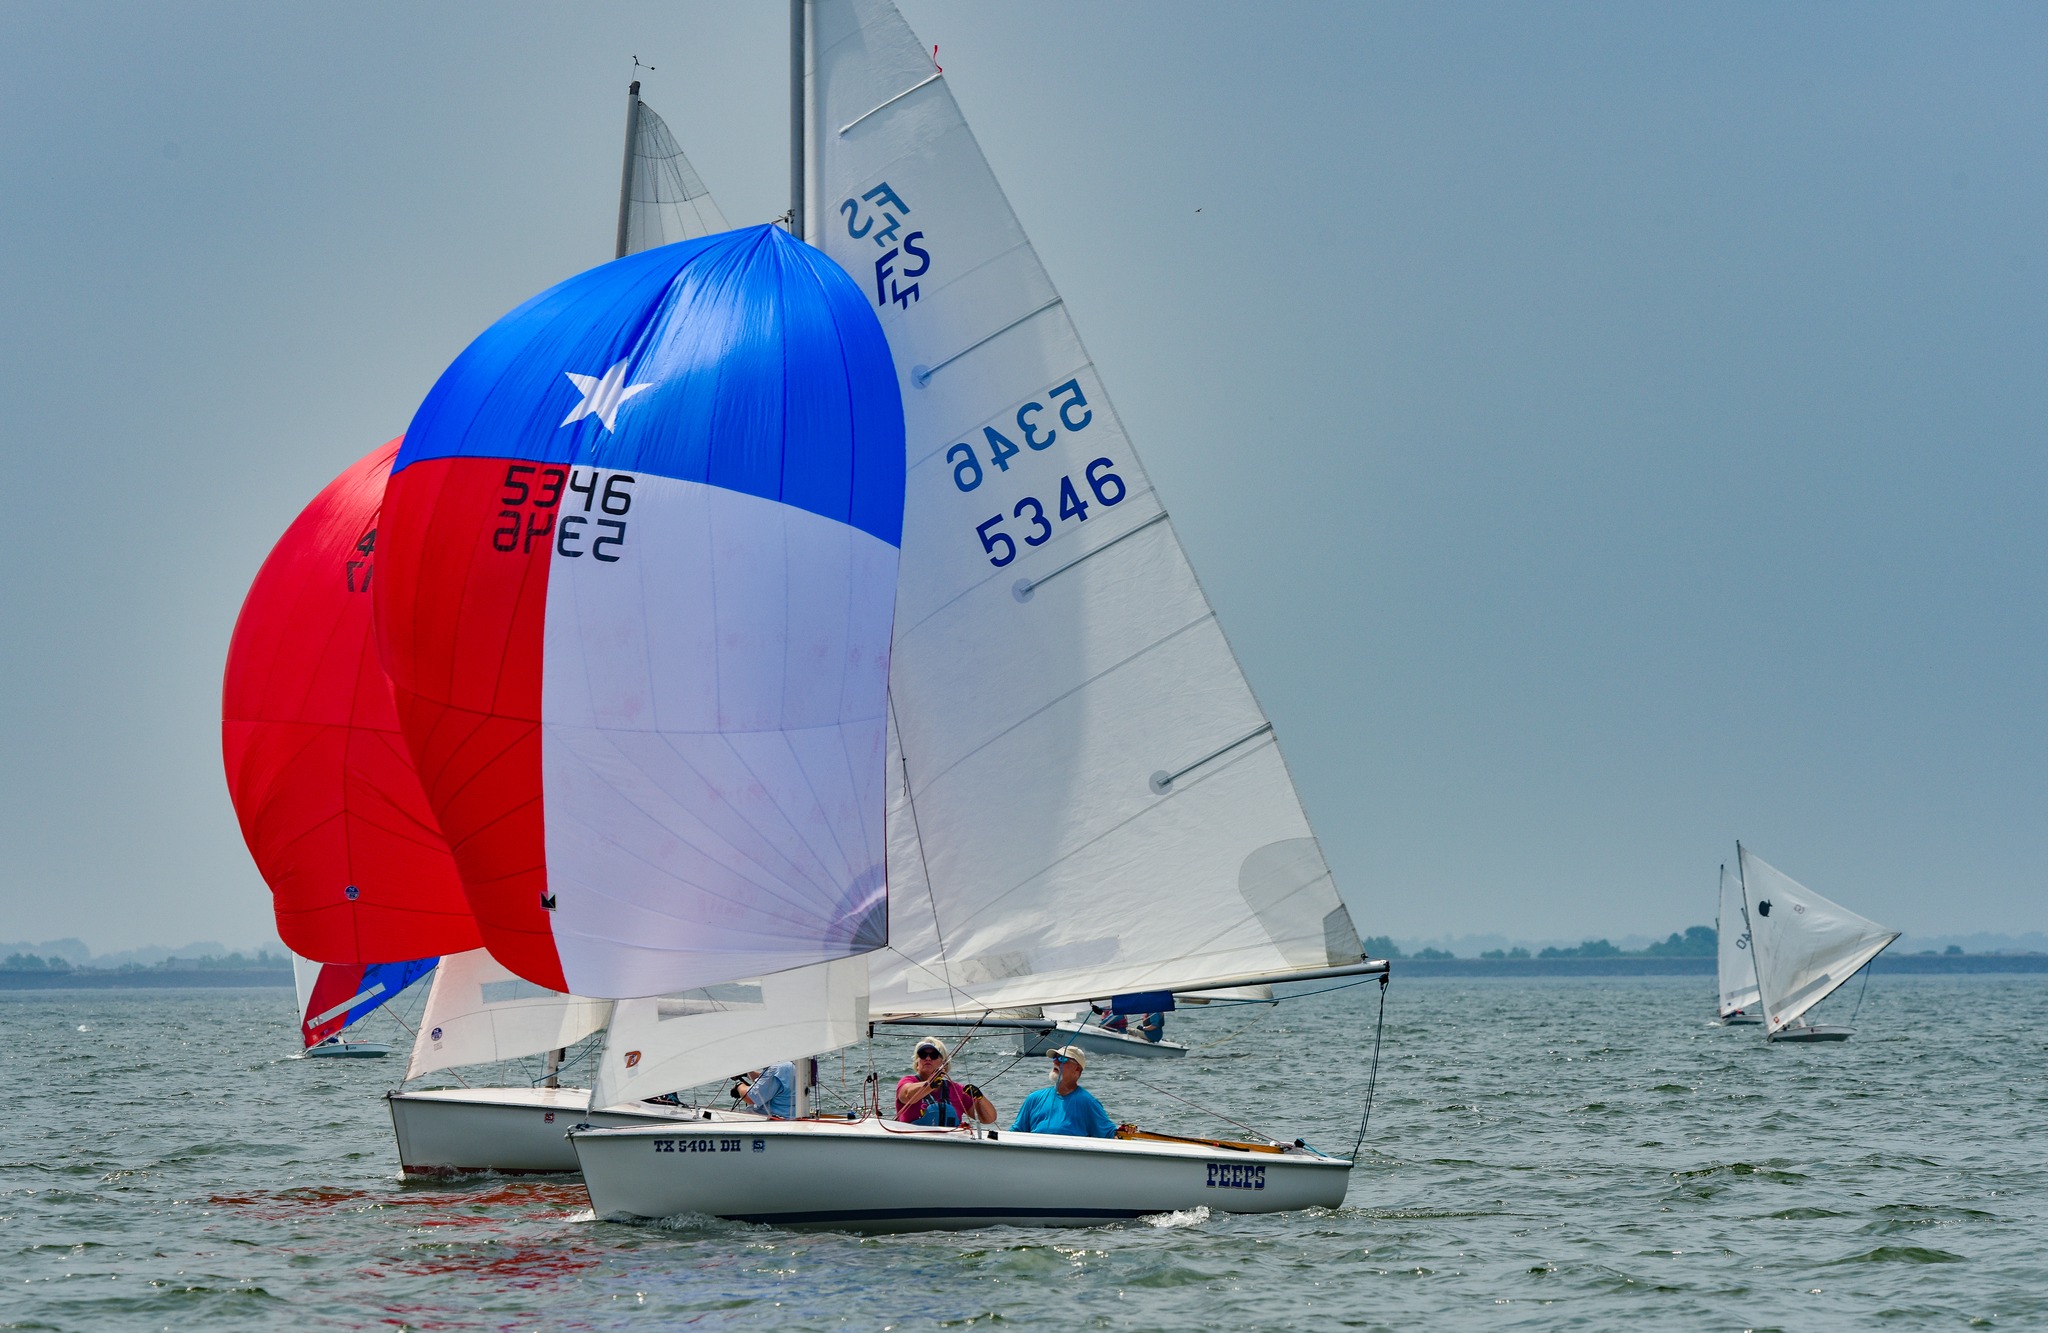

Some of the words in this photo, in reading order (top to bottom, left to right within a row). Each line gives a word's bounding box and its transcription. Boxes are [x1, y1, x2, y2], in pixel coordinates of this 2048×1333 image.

[501, 465, 636, 516] 5346
[976, 457, 1126, 567] 5346
[654, 1139, 675, 1153] TX
[678, 1139, 716, 1153] 5401
[720, 1139, 742, 1152] DH
[1206, 1163, 1266, 1190] PEEPS
